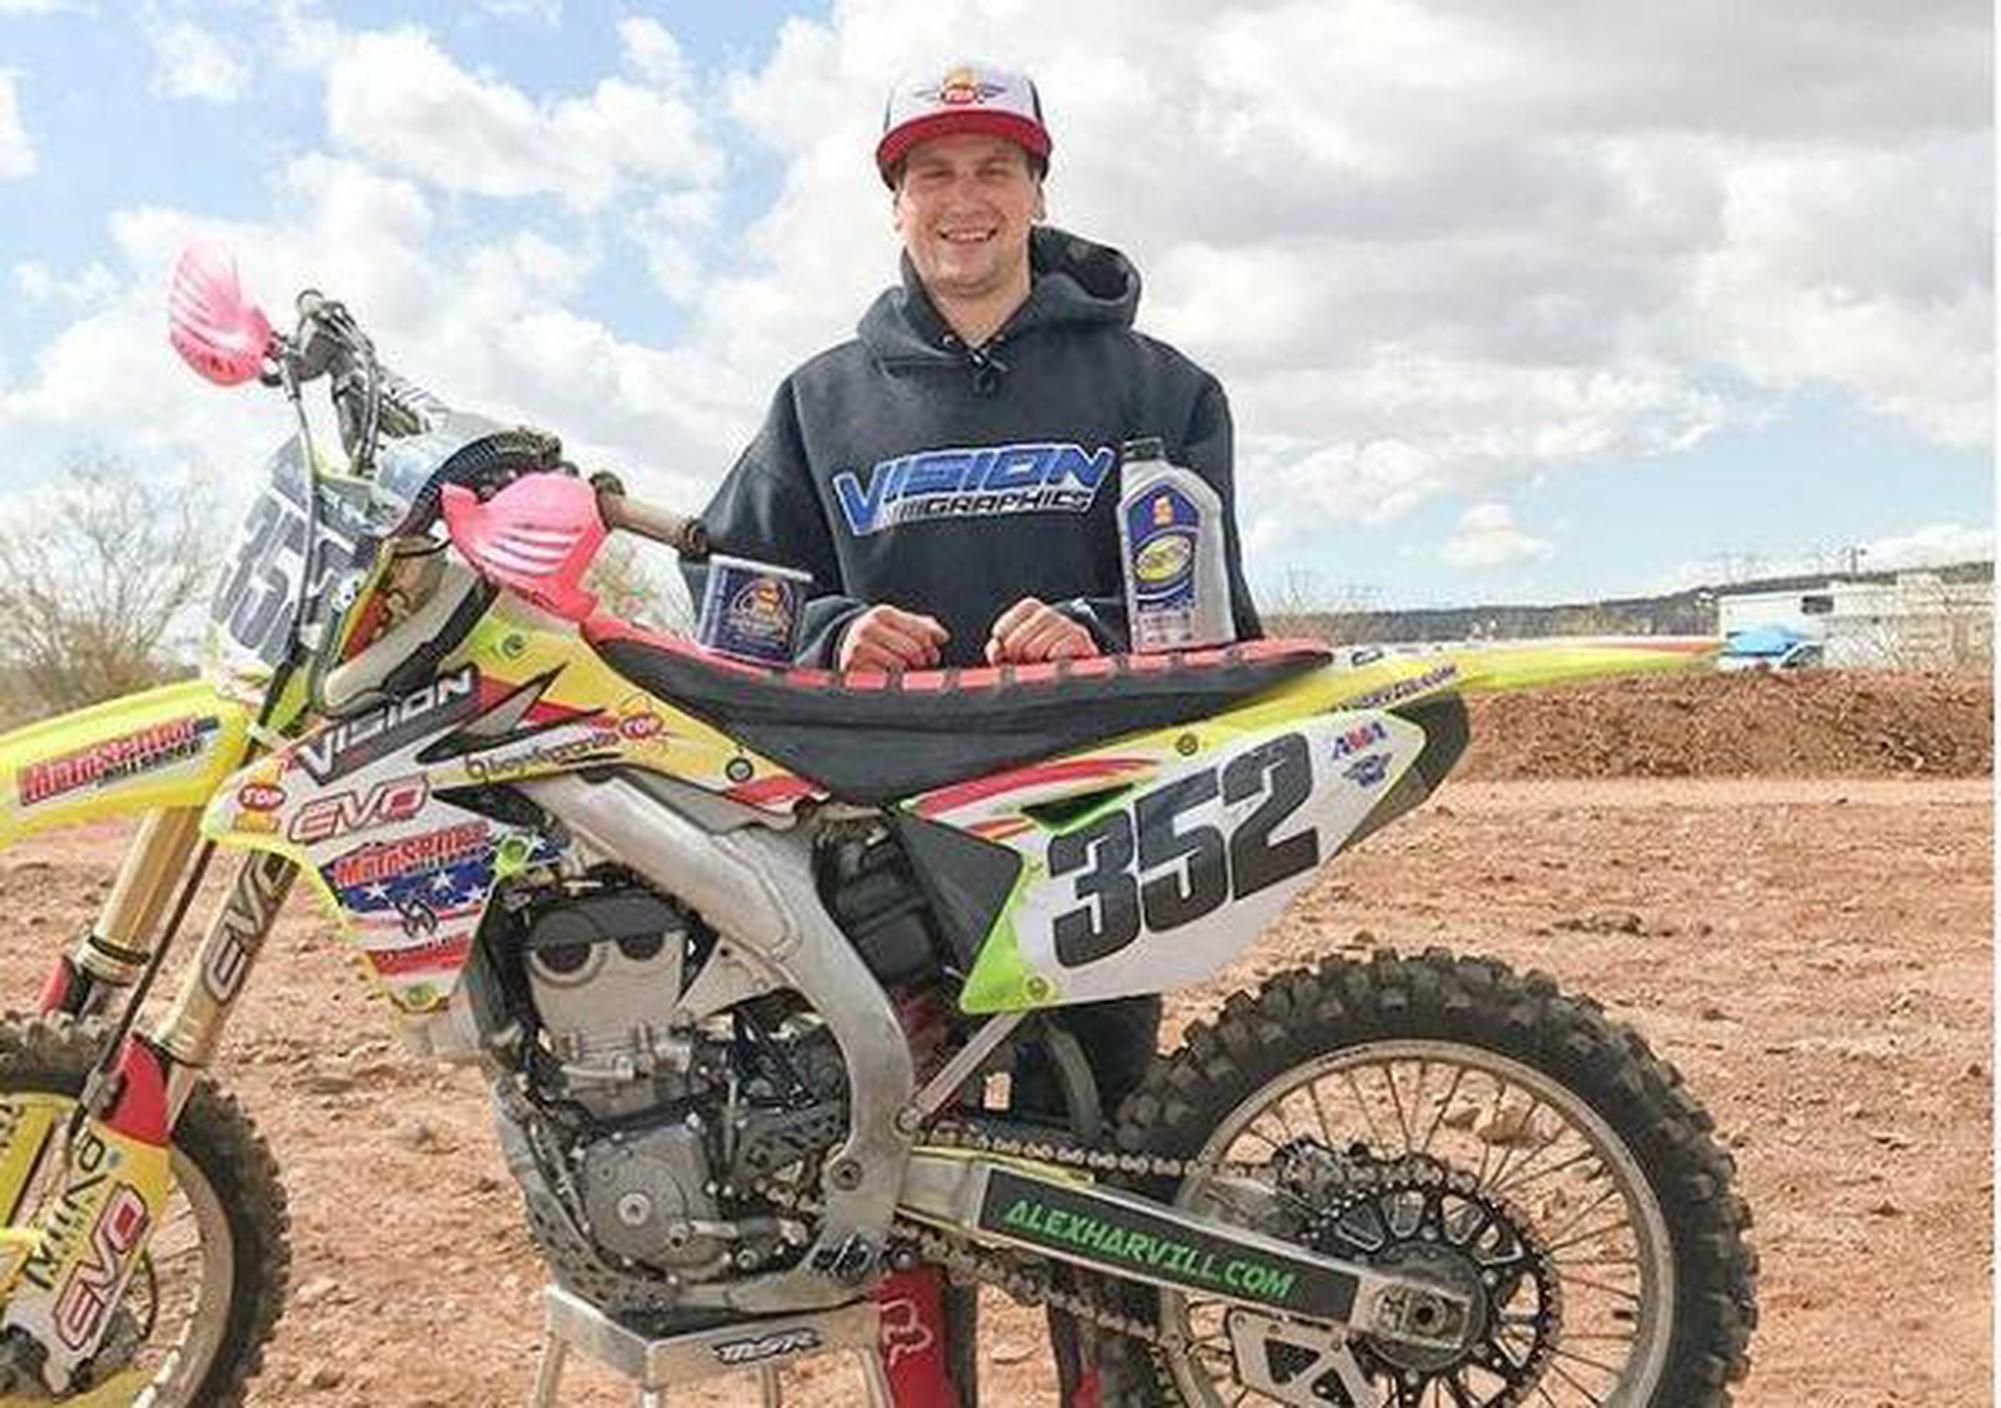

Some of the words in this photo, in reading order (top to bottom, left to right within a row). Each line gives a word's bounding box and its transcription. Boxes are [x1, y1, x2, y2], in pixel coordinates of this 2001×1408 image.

[833, 442, 1116, 536] VISION
[925, 487, 1092, 515] GRAPHICS
[297, 667, 472, 778] VISION
[288, 773, 428, 844] EVO
[1047, 731, 1319, 969] 352
[53, 1181, 150, 1351] EVO
